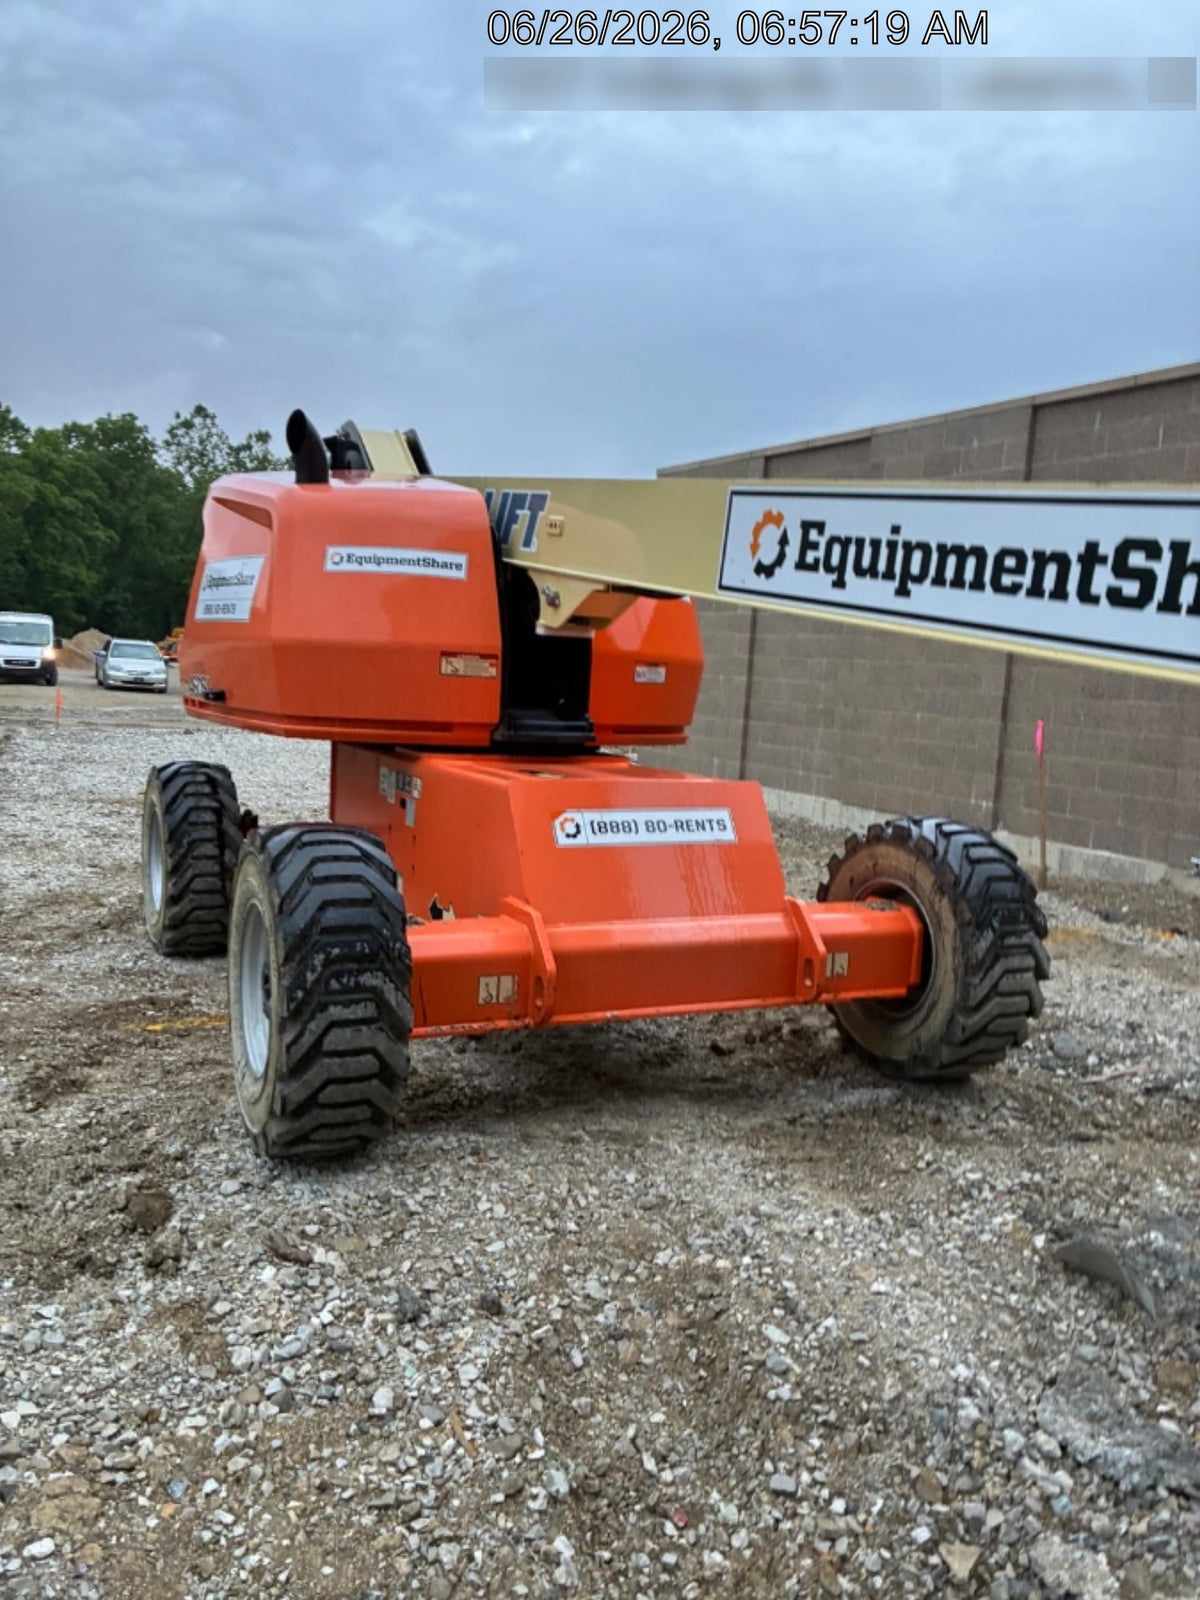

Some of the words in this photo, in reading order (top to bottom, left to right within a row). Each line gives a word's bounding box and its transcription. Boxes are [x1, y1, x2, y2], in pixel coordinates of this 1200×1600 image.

[345, 552, 463, 571] EquipmentShare
[795, 520, 1200, 617] EquipmentSh
[590, 819, 639, 835] (888)
[644, 818, 727, 833] 80-RENTS
